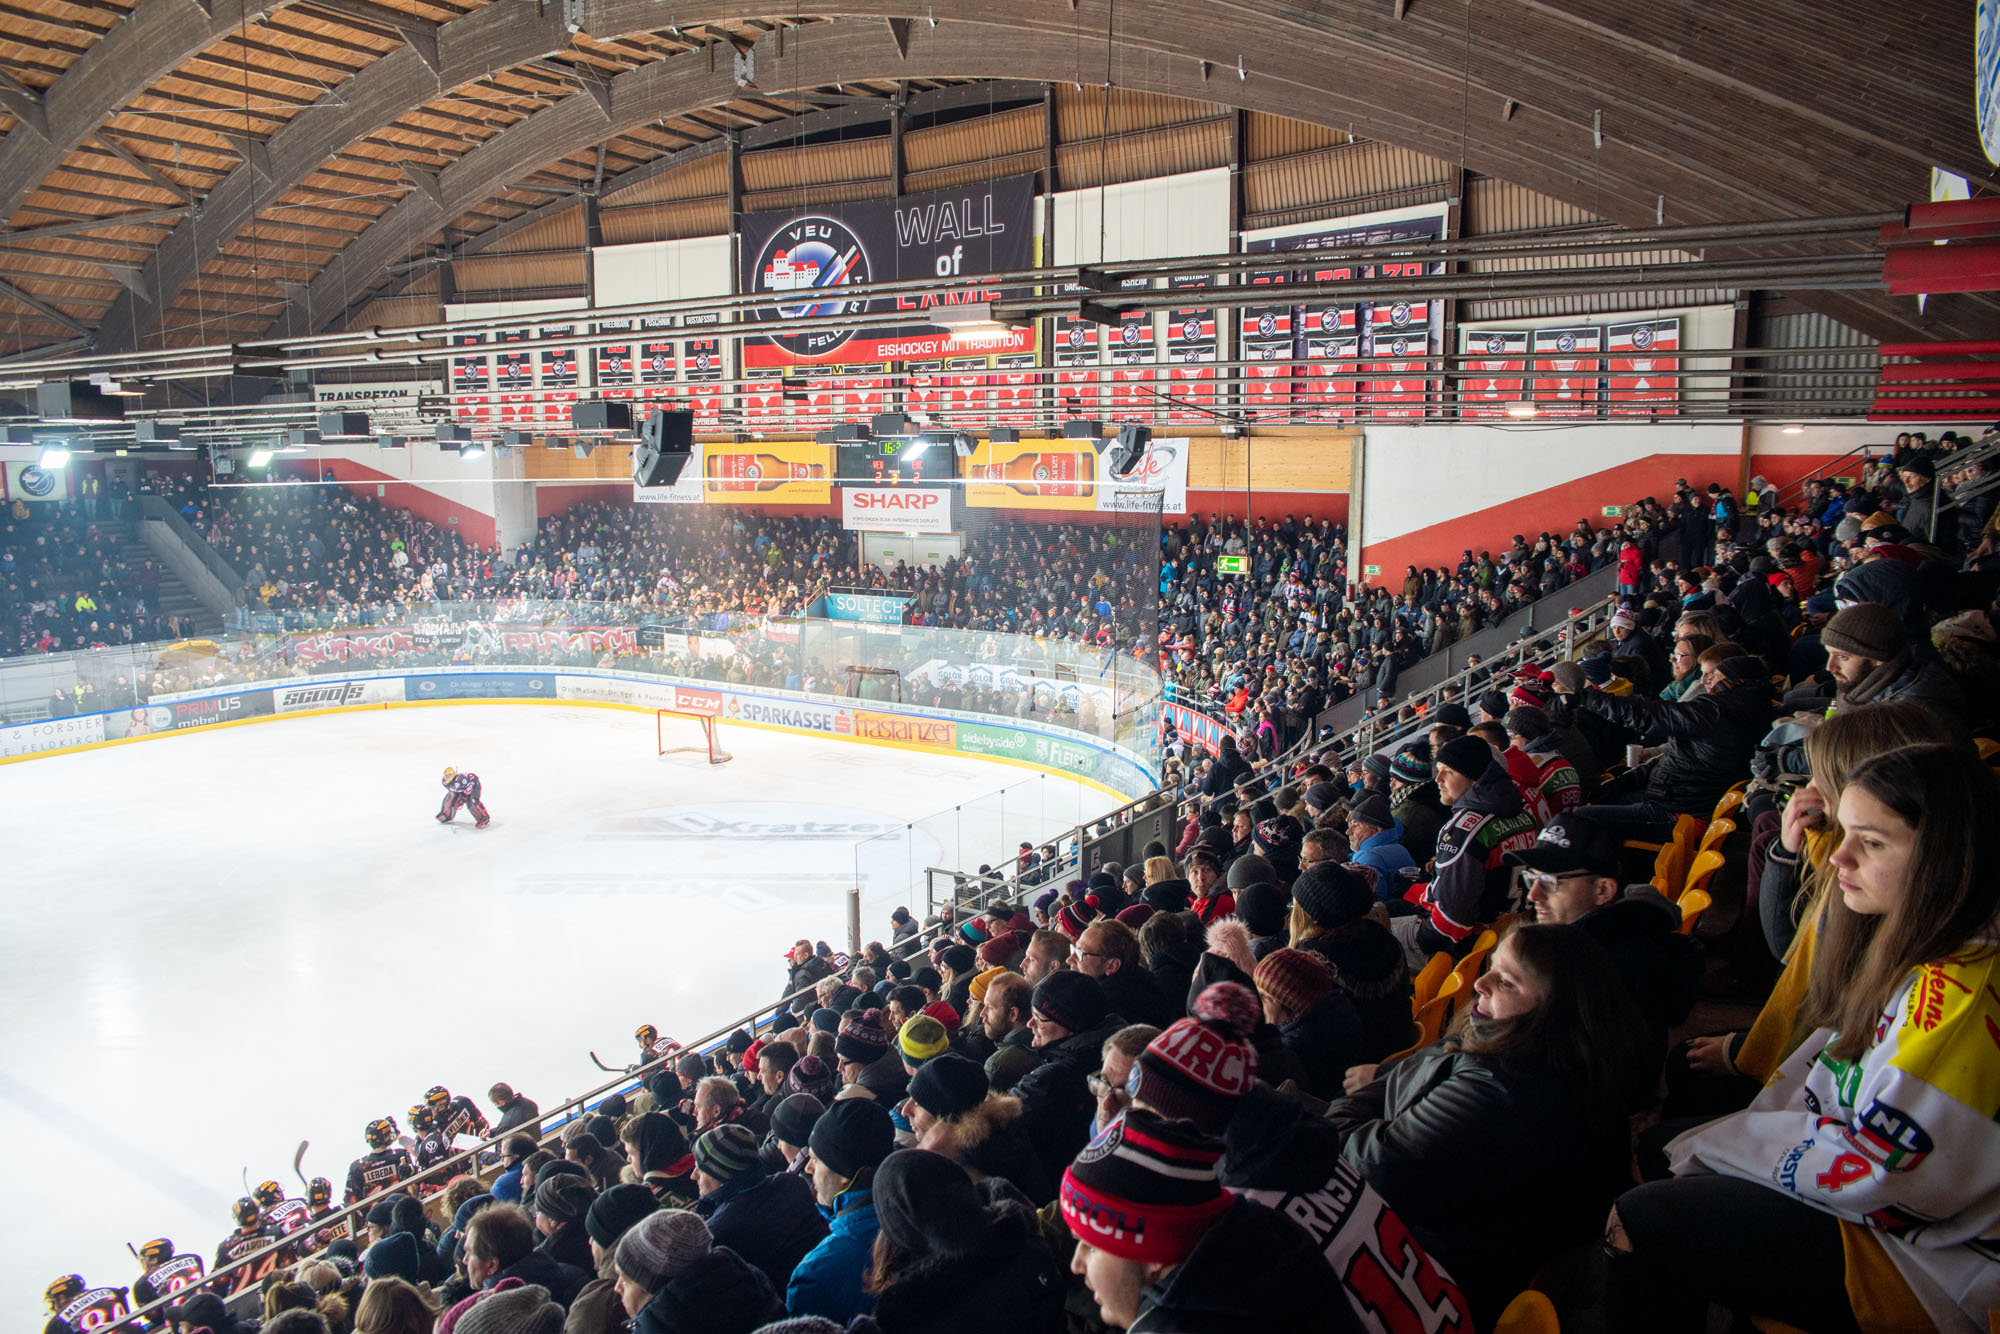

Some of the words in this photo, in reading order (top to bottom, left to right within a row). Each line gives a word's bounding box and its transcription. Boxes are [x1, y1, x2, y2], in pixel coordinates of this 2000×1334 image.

[895, 194, 1005, 247] WALL
[788, 225, 832, 241] VEU
[936, 246, 963, 277] of
[877, 341, 938, 357] EISHOCKEY
[941, 336, 960, 352] MIT
[965, 333, 1024, 351] TRADITION
[639, 493, 700, 502] www.life-fitness.at
[853, 493, 939, 510] SHARP
[1103, 499, 1182, 511] www.life-fitness.at
[837, 596, 903, 614] SOLTECH
[968, 673, 993, 682] GOLOB
[176, 696, 241, 717] PRIMUS
[677, 695, 721, 709] CCM
[178, 713, 219, 729] möbel
[743, 703, 833, 732] SPARKASSE
[33, 717, 103, 737] FORSTER
[854, 711, 956, 744] frastanzer
[22, 733, 104, 754] FELDKIRCH
[962, 731, 1015, 749] sidebyside
[1462, 814, 1482, 831] FBI
[1493, 813, 1533, 837] SAMINA
[366, 1166, 394, 1181] LEBEDA
[1816, 1153, 1872, 1192] 4
